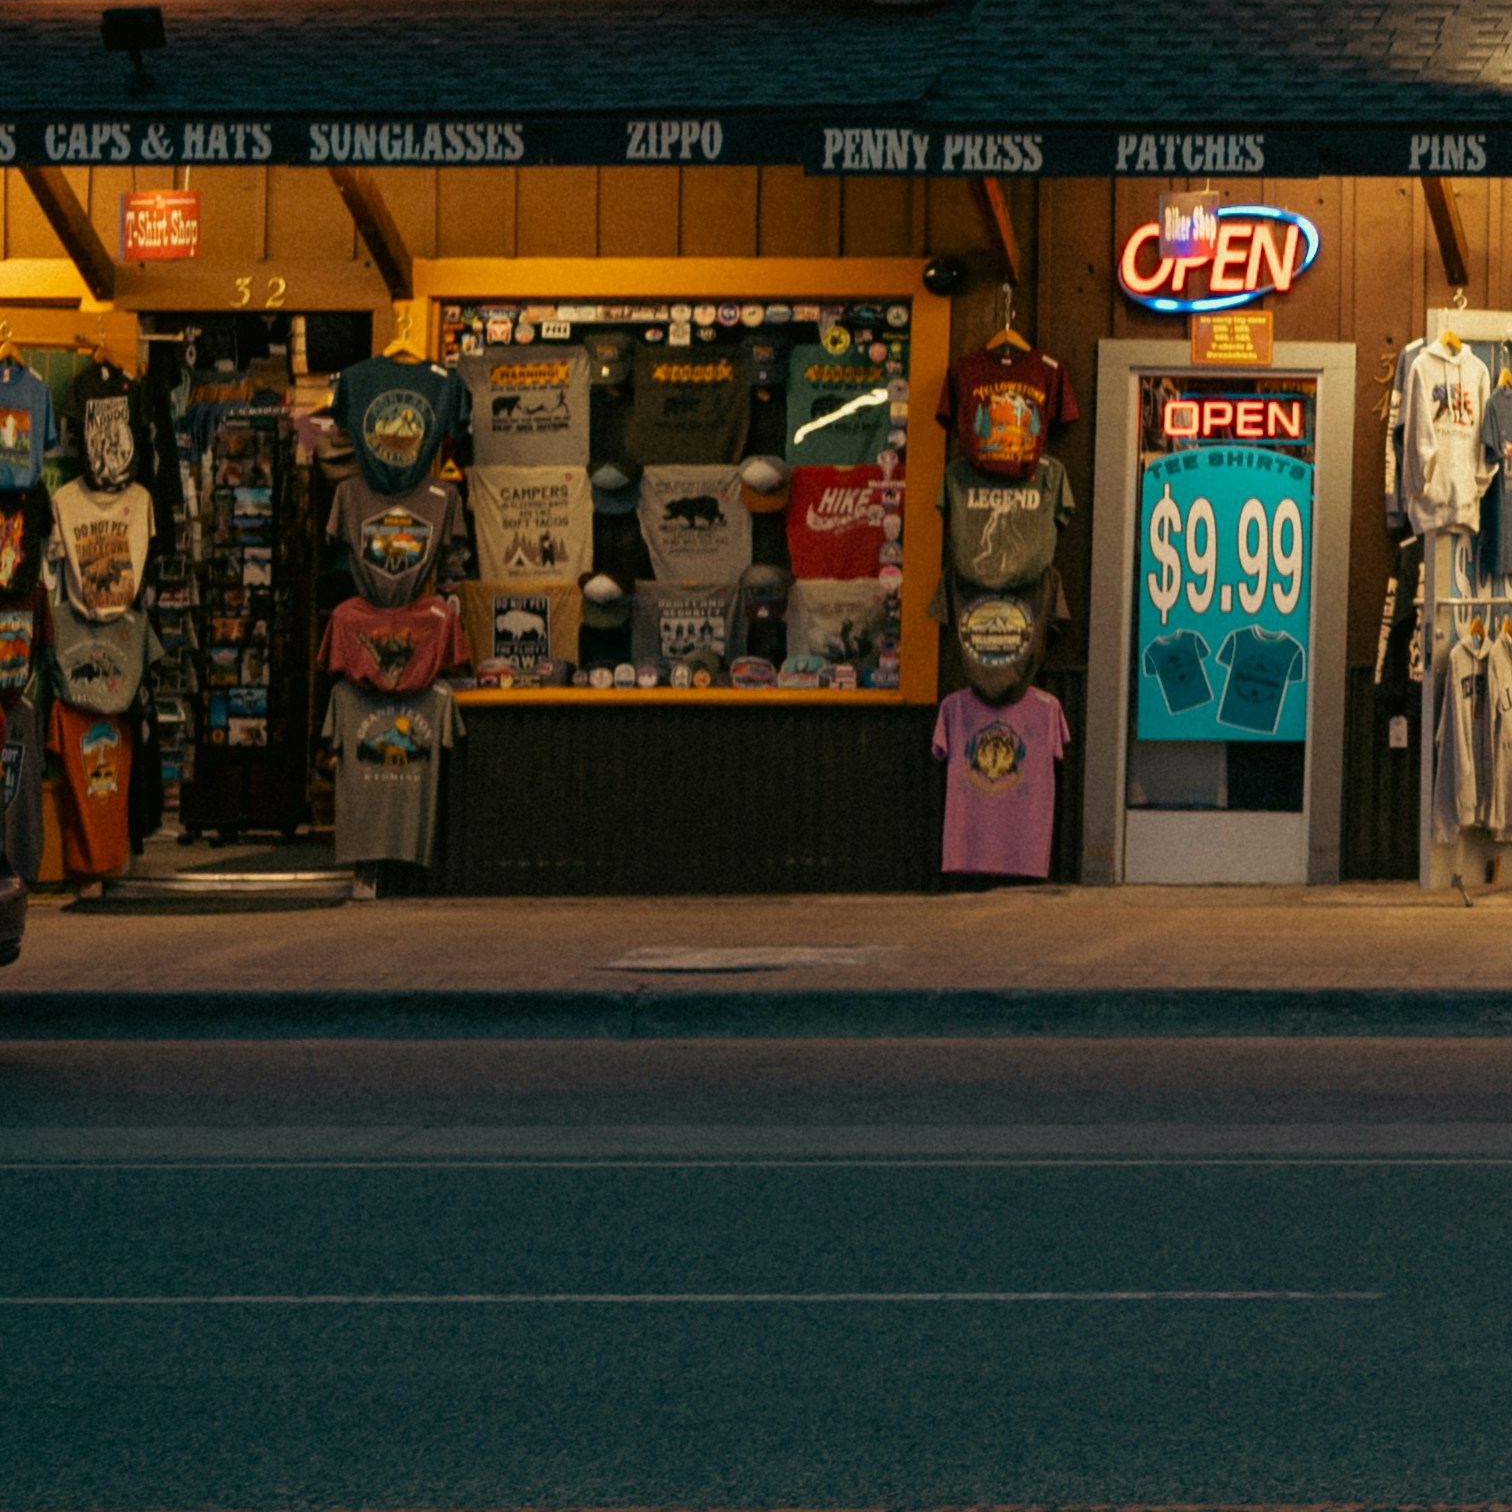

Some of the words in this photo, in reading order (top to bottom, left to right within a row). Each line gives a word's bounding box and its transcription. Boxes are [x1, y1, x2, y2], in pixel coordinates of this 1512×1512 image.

[45, 121, 131, 161] CAPS
[141, 124, 174, 160] &
[181, 121, 272, 160] HATS
[309, 121, 525, 161] SUNGLASSES
[626, 119, 723, 160] ZIPPO
[821, 128, 934, 171] PENNY
[943, 134, 1044, 173] PRESS
[1115, 132, 1266, 172] PATCHES
[1408, 132, 1487, 173] PINS
[126, 209, 168, 248] T-Shirt
[170, 208, 198, 257] Shop
[1164, 206, 1191, 242] Biker
[1192, 204, 1217, 250] Shop
[230, 276, 287, 309] 32
[1163, 400, 1303, 438] OPEN
[1150, 453, 1200, 481] TEE
[1207, 450, 1308, 481] SHIRTS
[500, 484, 569, 501] CAMPERS
[818, 486, 875, 515] HIKE
[967, 487, 1041, 510] LEGEND
[73, 525, 89, 540] DO
[90, 522, 109, 535] NOT
[110, 521, 128, 534] PET
[502, 517, 530, 529] SOFT
[535, 516, 569, 528] TACOS
[1147, 481, 1305, 627] $9.99
